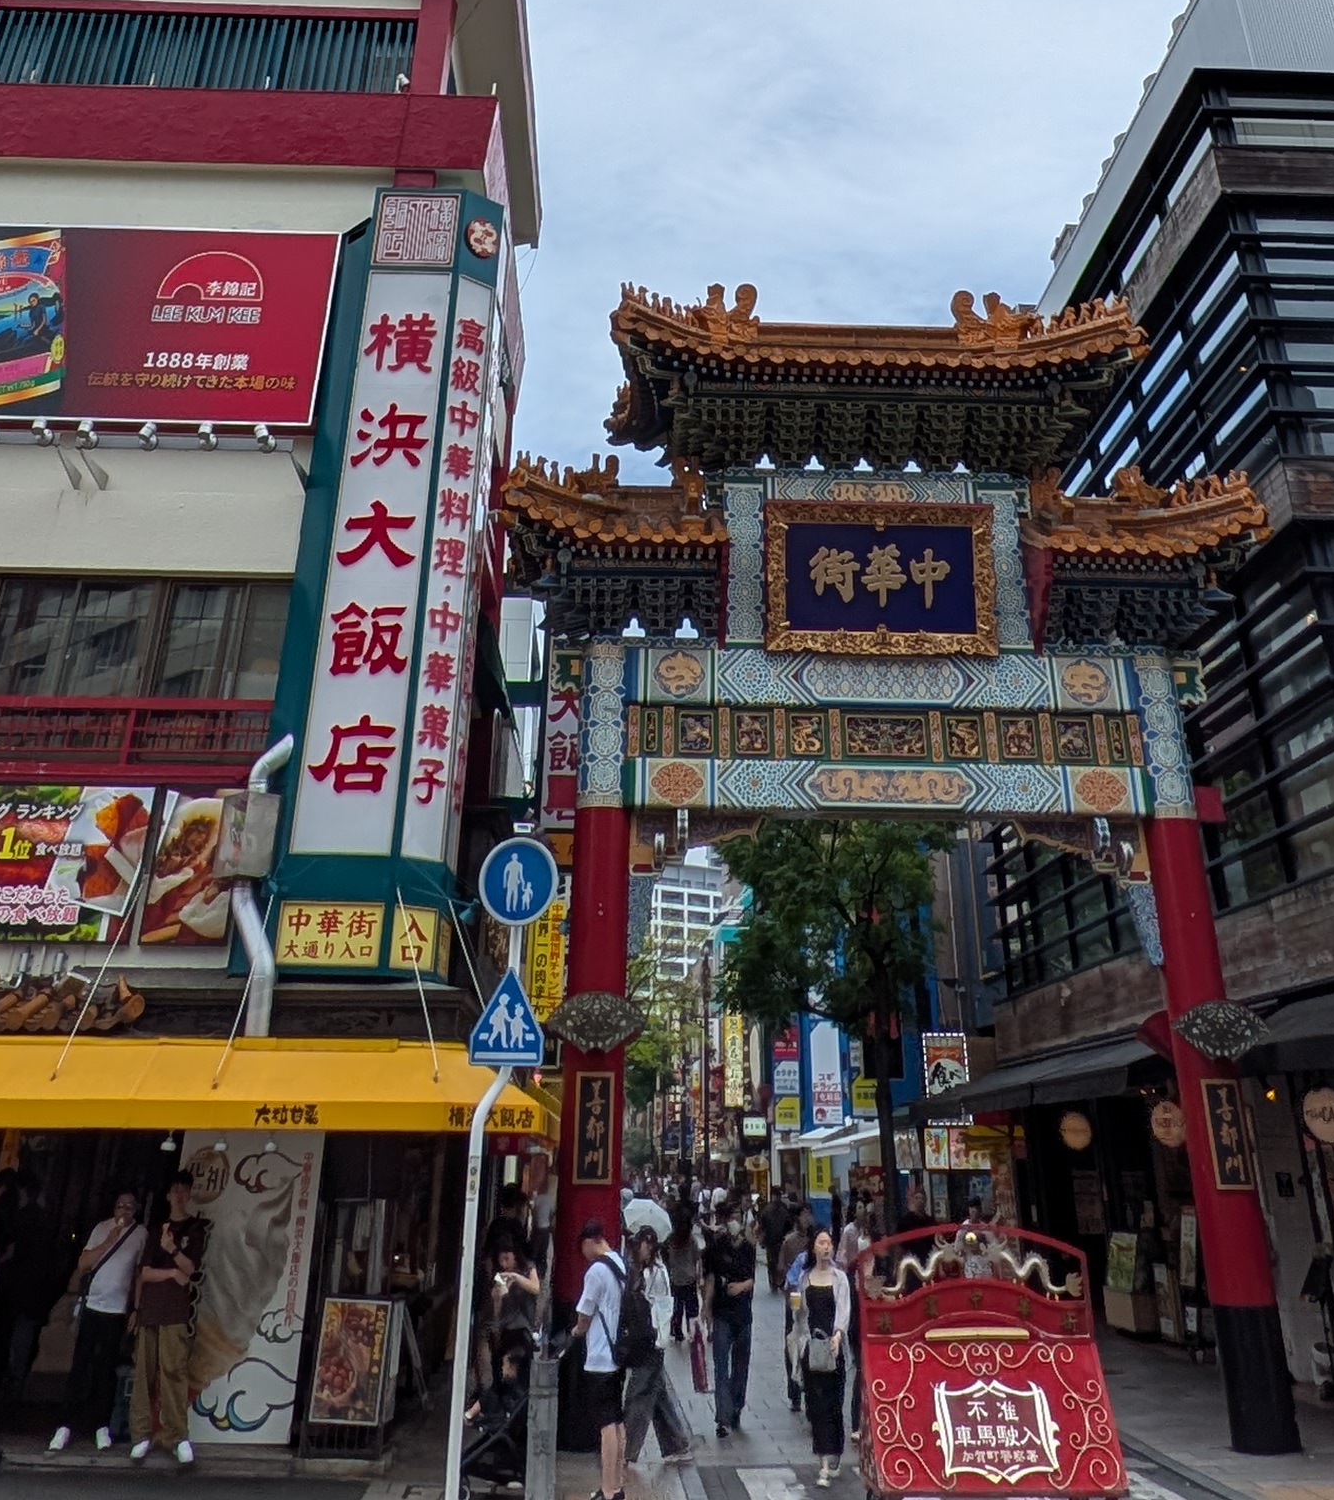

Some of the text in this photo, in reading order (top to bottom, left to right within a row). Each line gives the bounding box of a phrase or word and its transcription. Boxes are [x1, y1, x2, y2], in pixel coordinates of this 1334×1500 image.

[205, 280, 258, 297] 李錦記
[151, 304, 263, 325] LEE KUM KEE
[143, 351, 250, 371] 1888年創業
[87, 371, 297, 391] 伝統を守り続けてきた本場の味
[308, 312, 438, 794] 横浜大飯店
[412, 317, 487, 805] 高級中華料理・中華菓子
[808, 543, 952, 609] 中華街
[16, 803, 85, 820] ランキング
[288, 908, 378, 939] 中華街
[283, 939, 373, 959] 大通り入口
[399, 913, 428, 964] 入口
[966, 1400, 1020, 1422] 不准
[954, 1424, 1042, 1449] 車馬駛入
